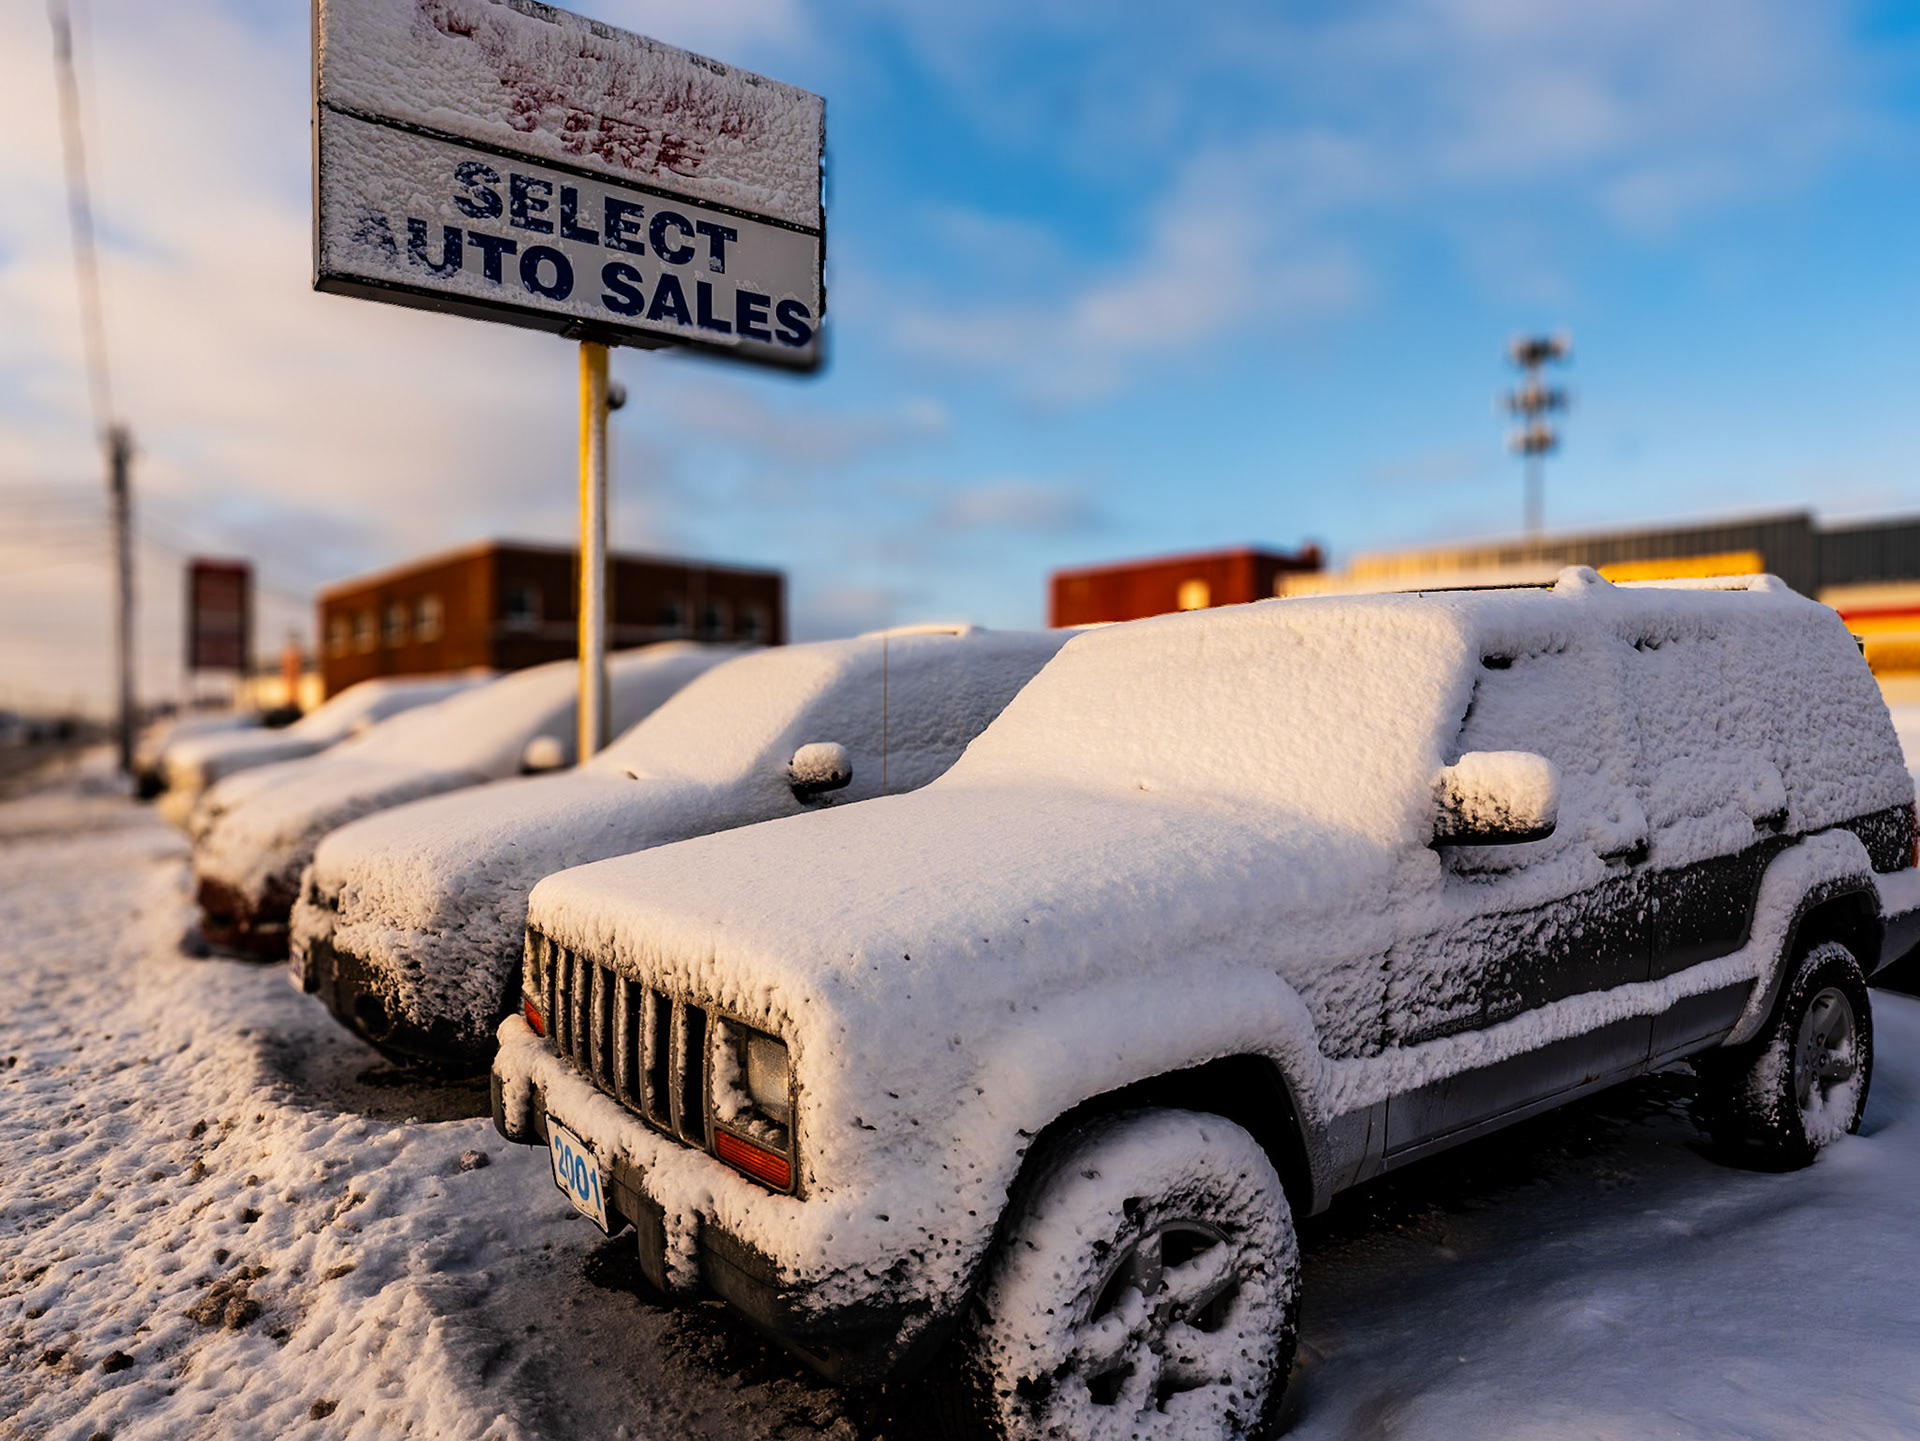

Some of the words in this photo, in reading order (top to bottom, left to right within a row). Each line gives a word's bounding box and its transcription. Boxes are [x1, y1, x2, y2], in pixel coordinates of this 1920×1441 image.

[453, 161, 738, 274] SELECT
[601, 261, 812, 347] SALES
[554, 1135, 602, 1212] 2001
